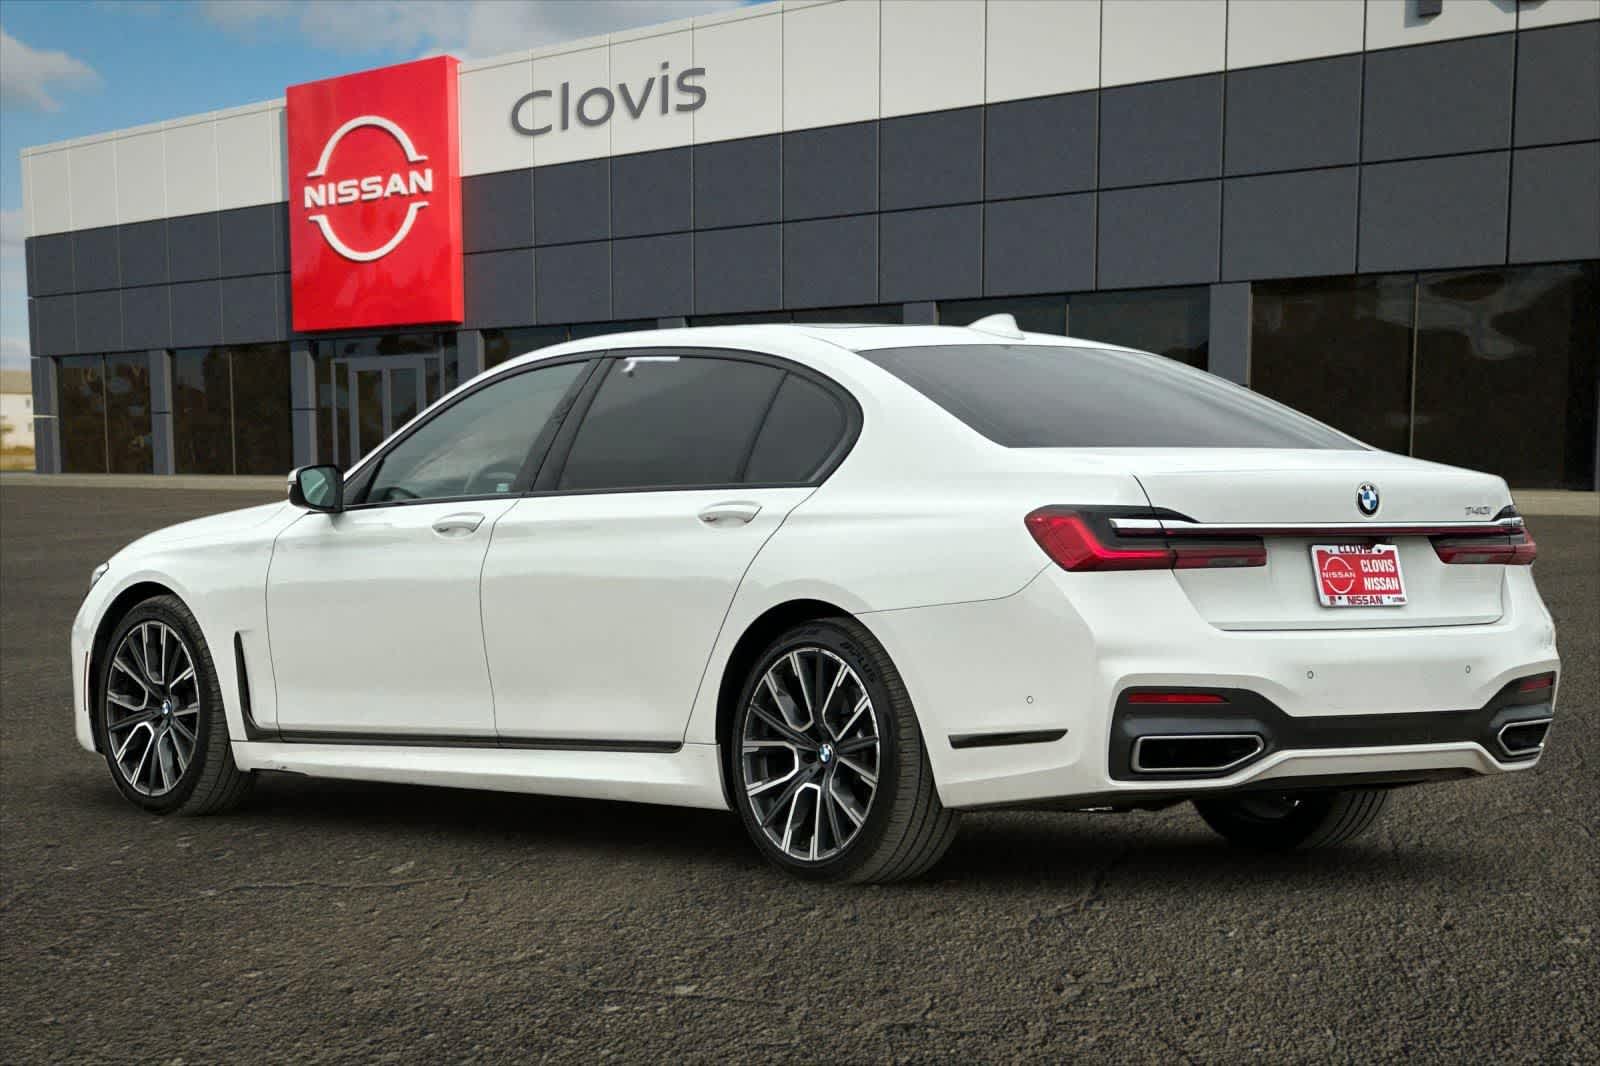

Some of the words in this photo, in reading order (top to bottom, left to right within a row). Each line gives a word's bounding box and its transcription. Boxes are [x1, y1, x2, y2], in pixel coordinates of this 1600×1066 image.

[510, 61, 707, 137] Clovis
[304, 167, 433, 209] NISSAN
[1360, 559, 1395, 573] CLOVIS
[1363, 577, 1400, 591] NISSAN
[1346, 595, 1384, 605] NISSAN
